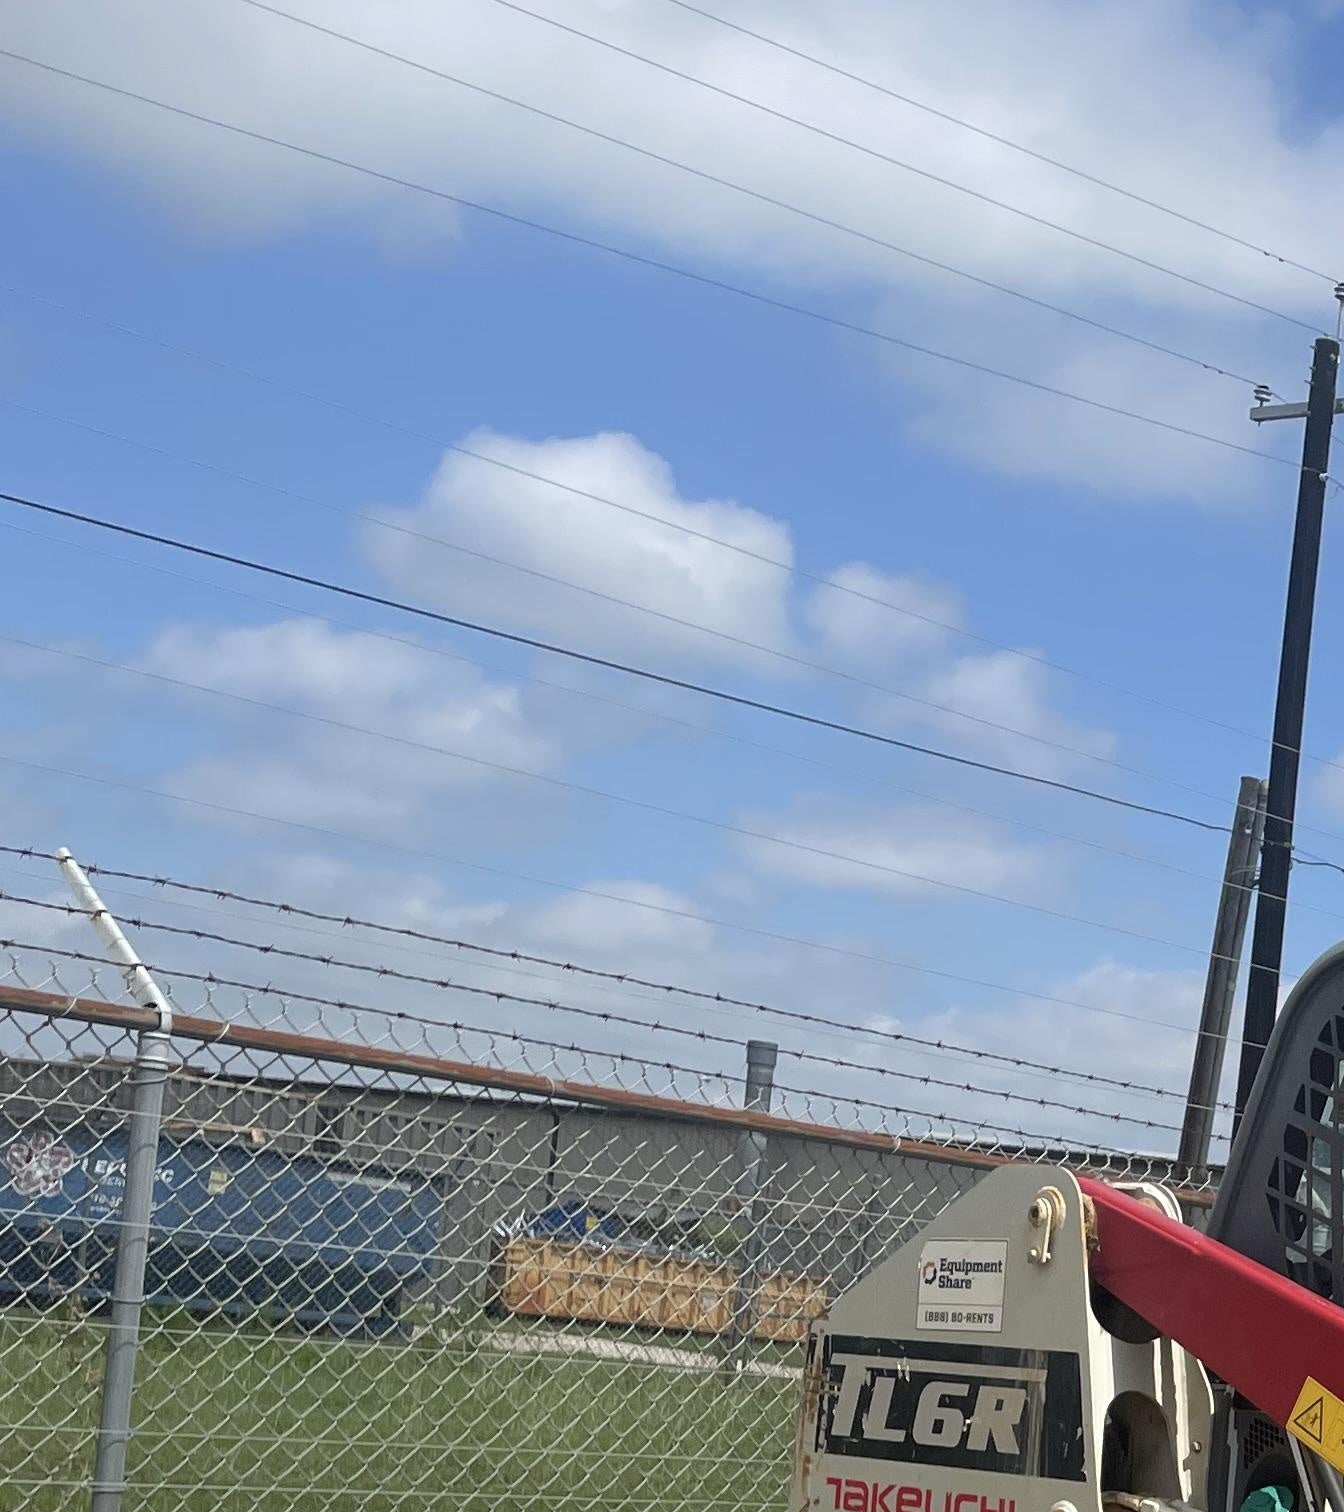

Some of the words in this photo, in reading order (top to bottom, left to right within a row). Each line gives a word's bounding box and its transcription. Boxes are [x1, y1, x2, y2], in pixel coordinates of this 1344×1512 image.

[940, 1258, 1003, 1275] Equipment
[938, 1275, 972, 1289] Share
[831, 1352, 1048, 1456] TL6R
